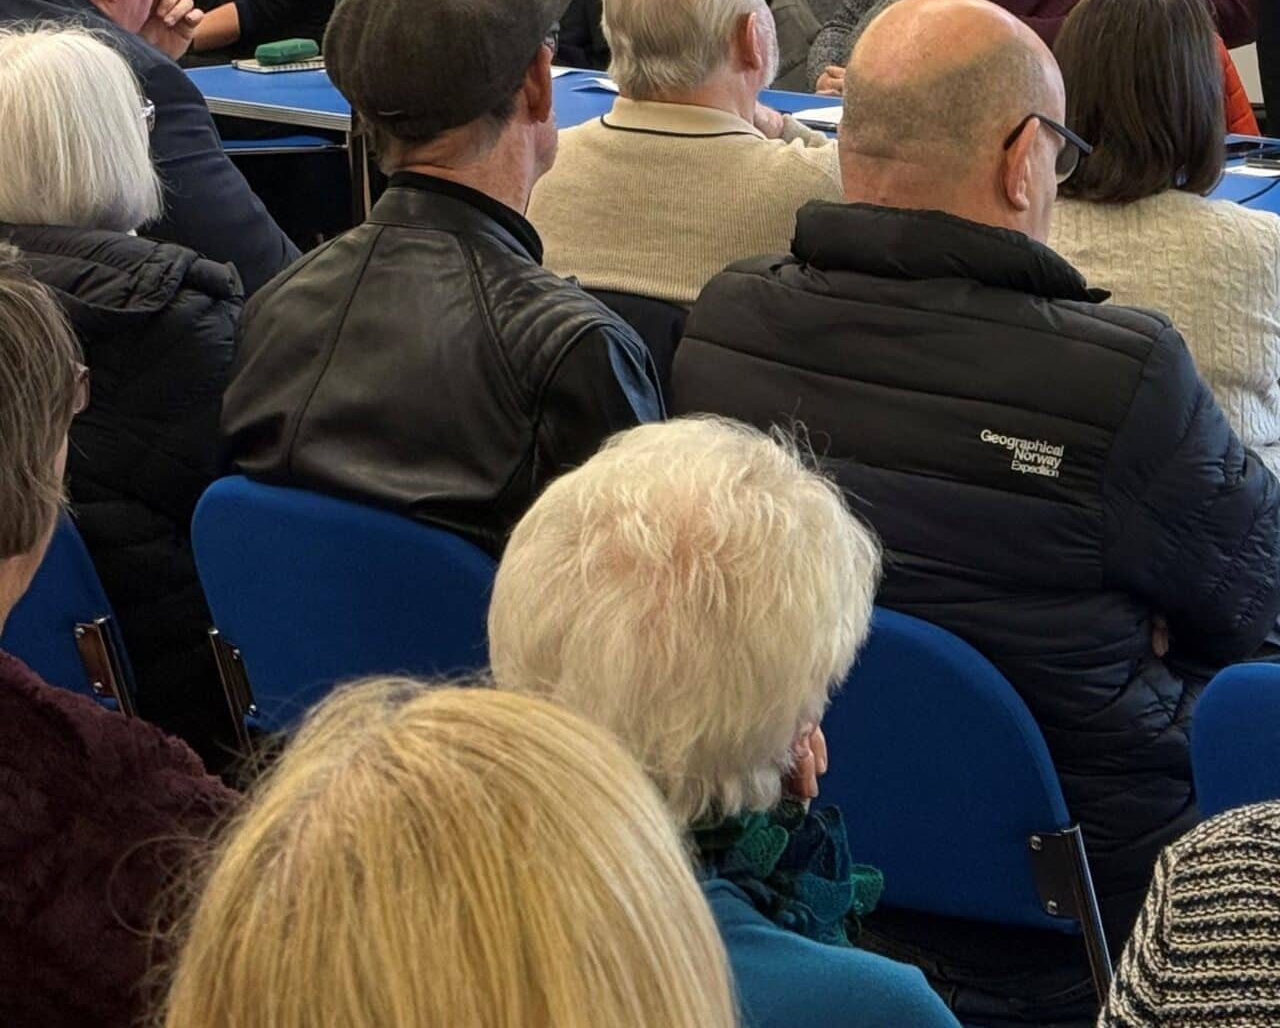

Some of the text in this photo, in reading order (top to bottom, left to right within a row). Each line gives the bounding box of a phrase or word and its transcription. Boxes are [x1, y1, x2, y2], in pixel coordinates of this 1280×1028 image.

[980, 429, 1064, 457] Geographical
[1011, 460, 1059, 478] Expedition
[1014, 448, 1062, 469] Norway
